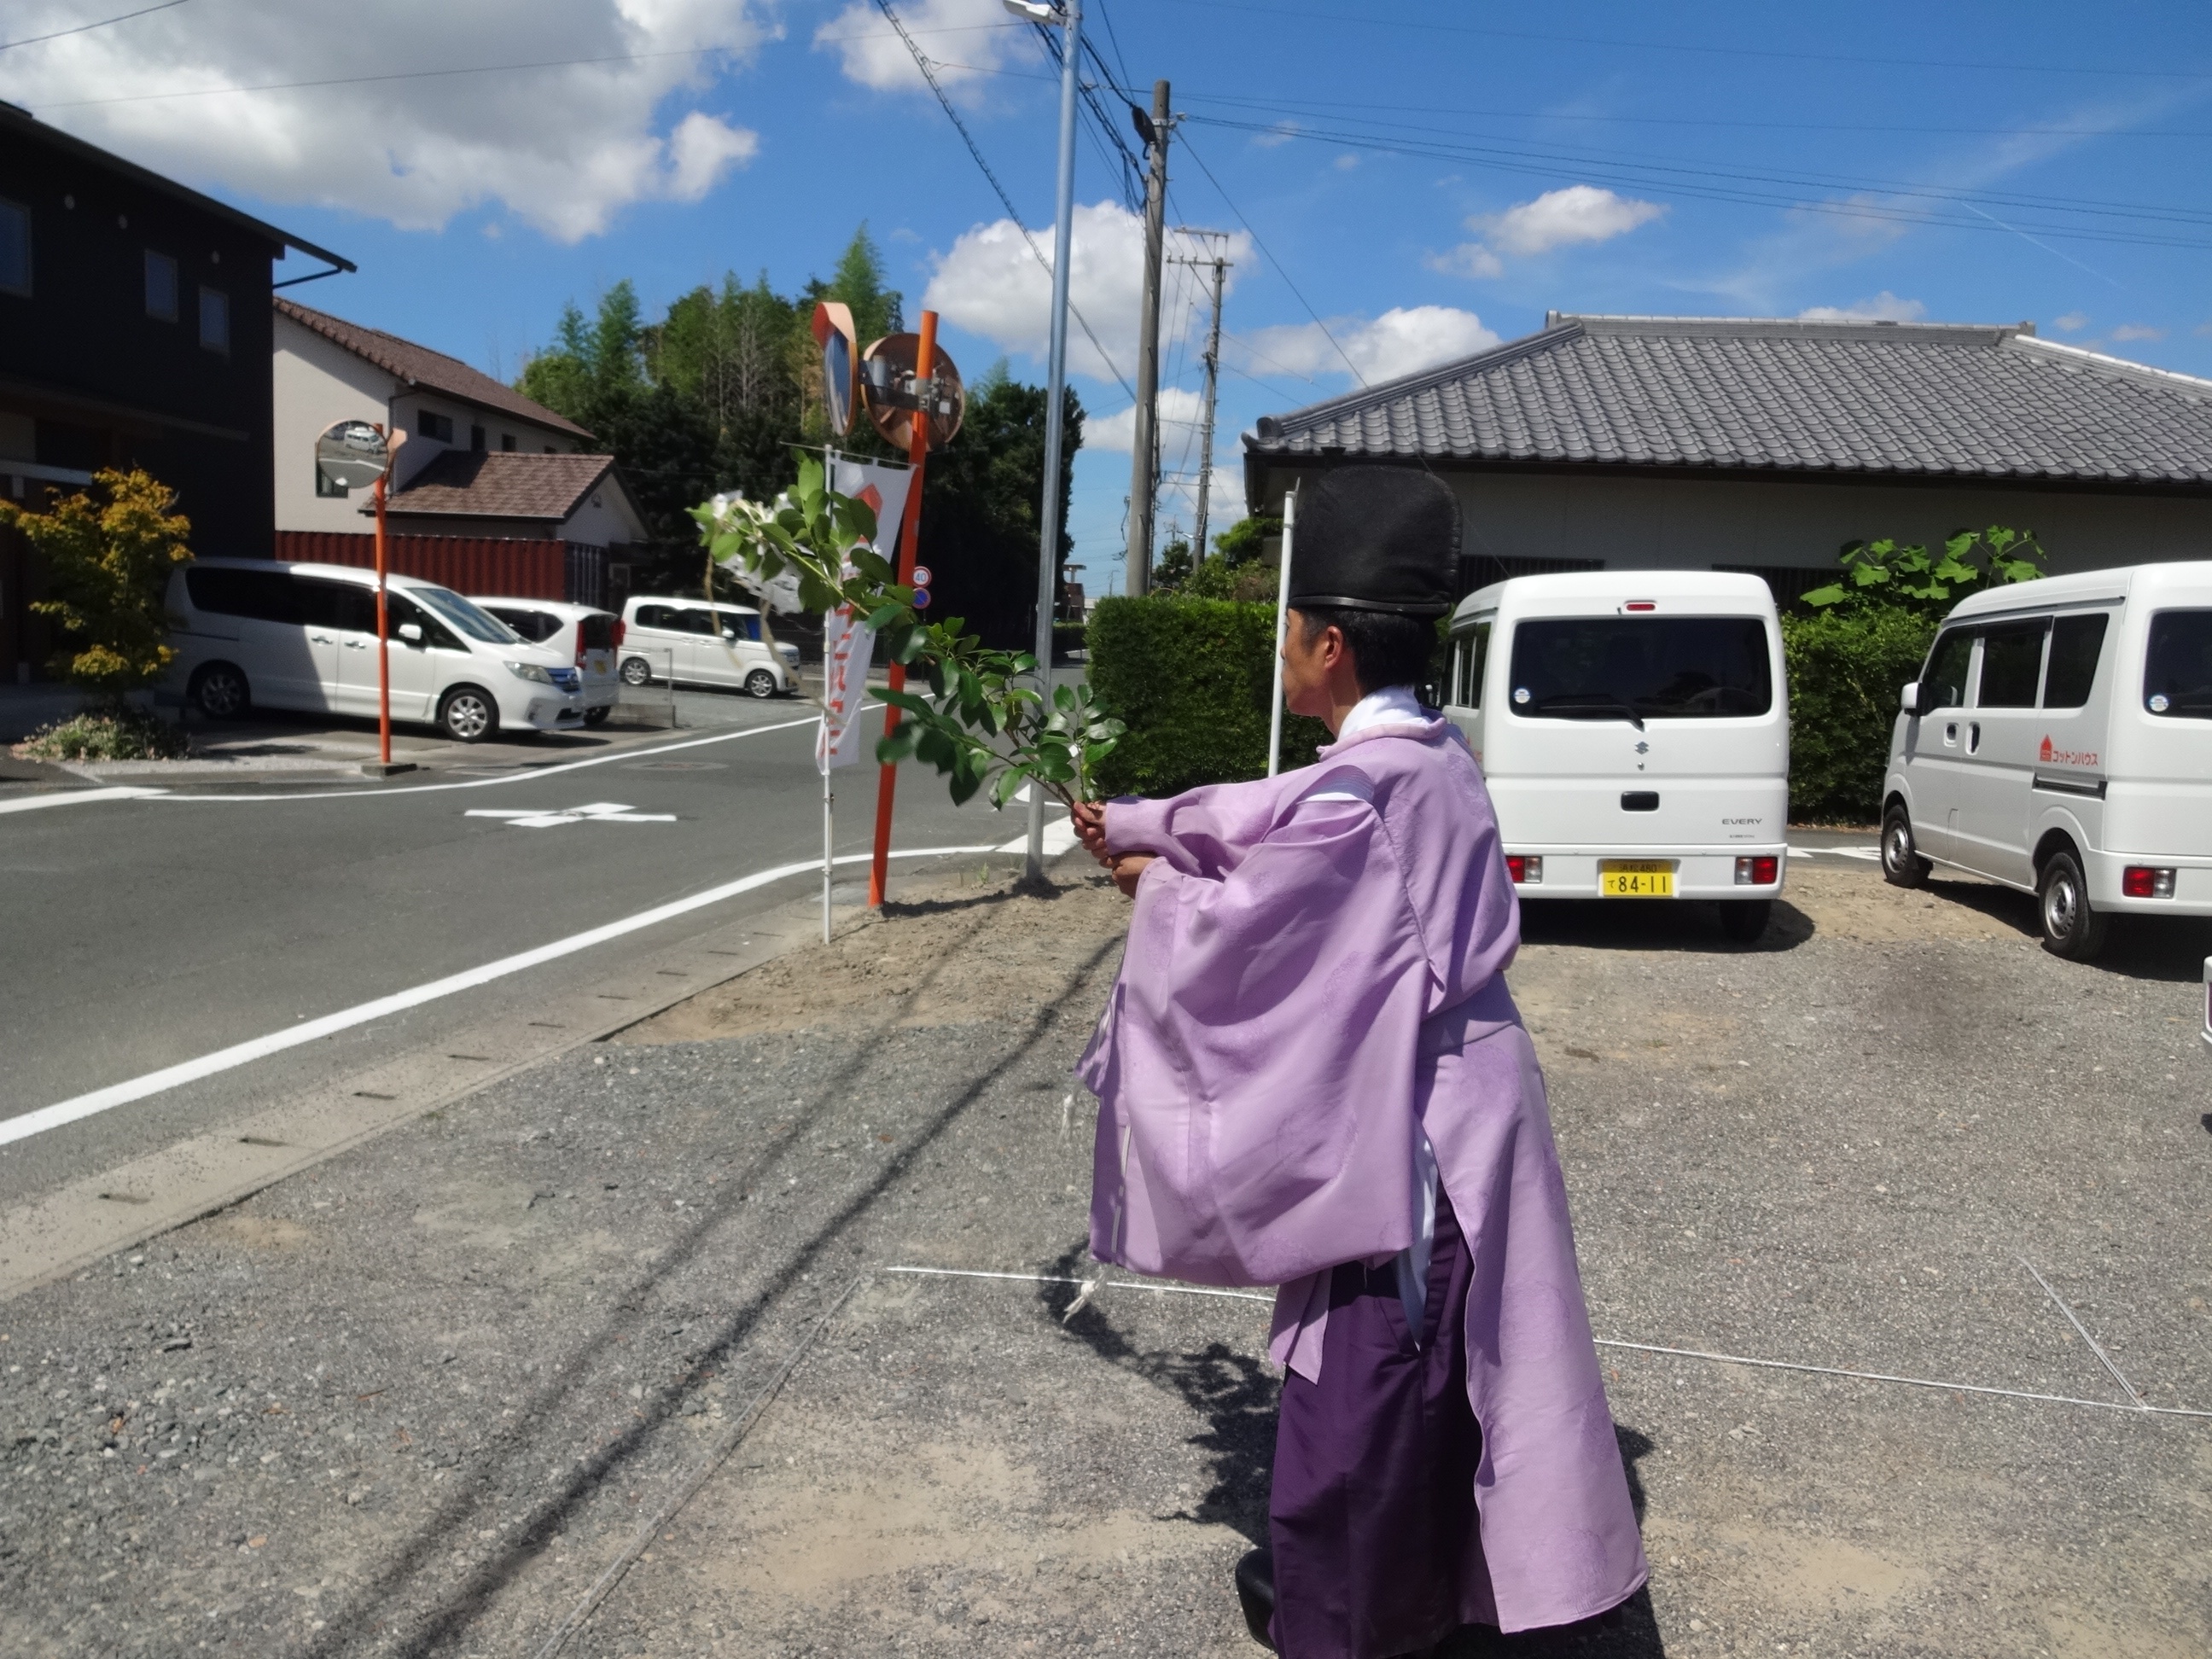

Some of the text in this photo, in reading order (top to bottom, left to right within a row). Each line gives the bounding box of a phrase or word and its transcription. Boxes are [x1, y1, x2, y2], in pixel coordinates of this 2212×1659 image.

[915, 573, 927, 582] 40
[2052, 750, 2099, 766] コットンハウス
